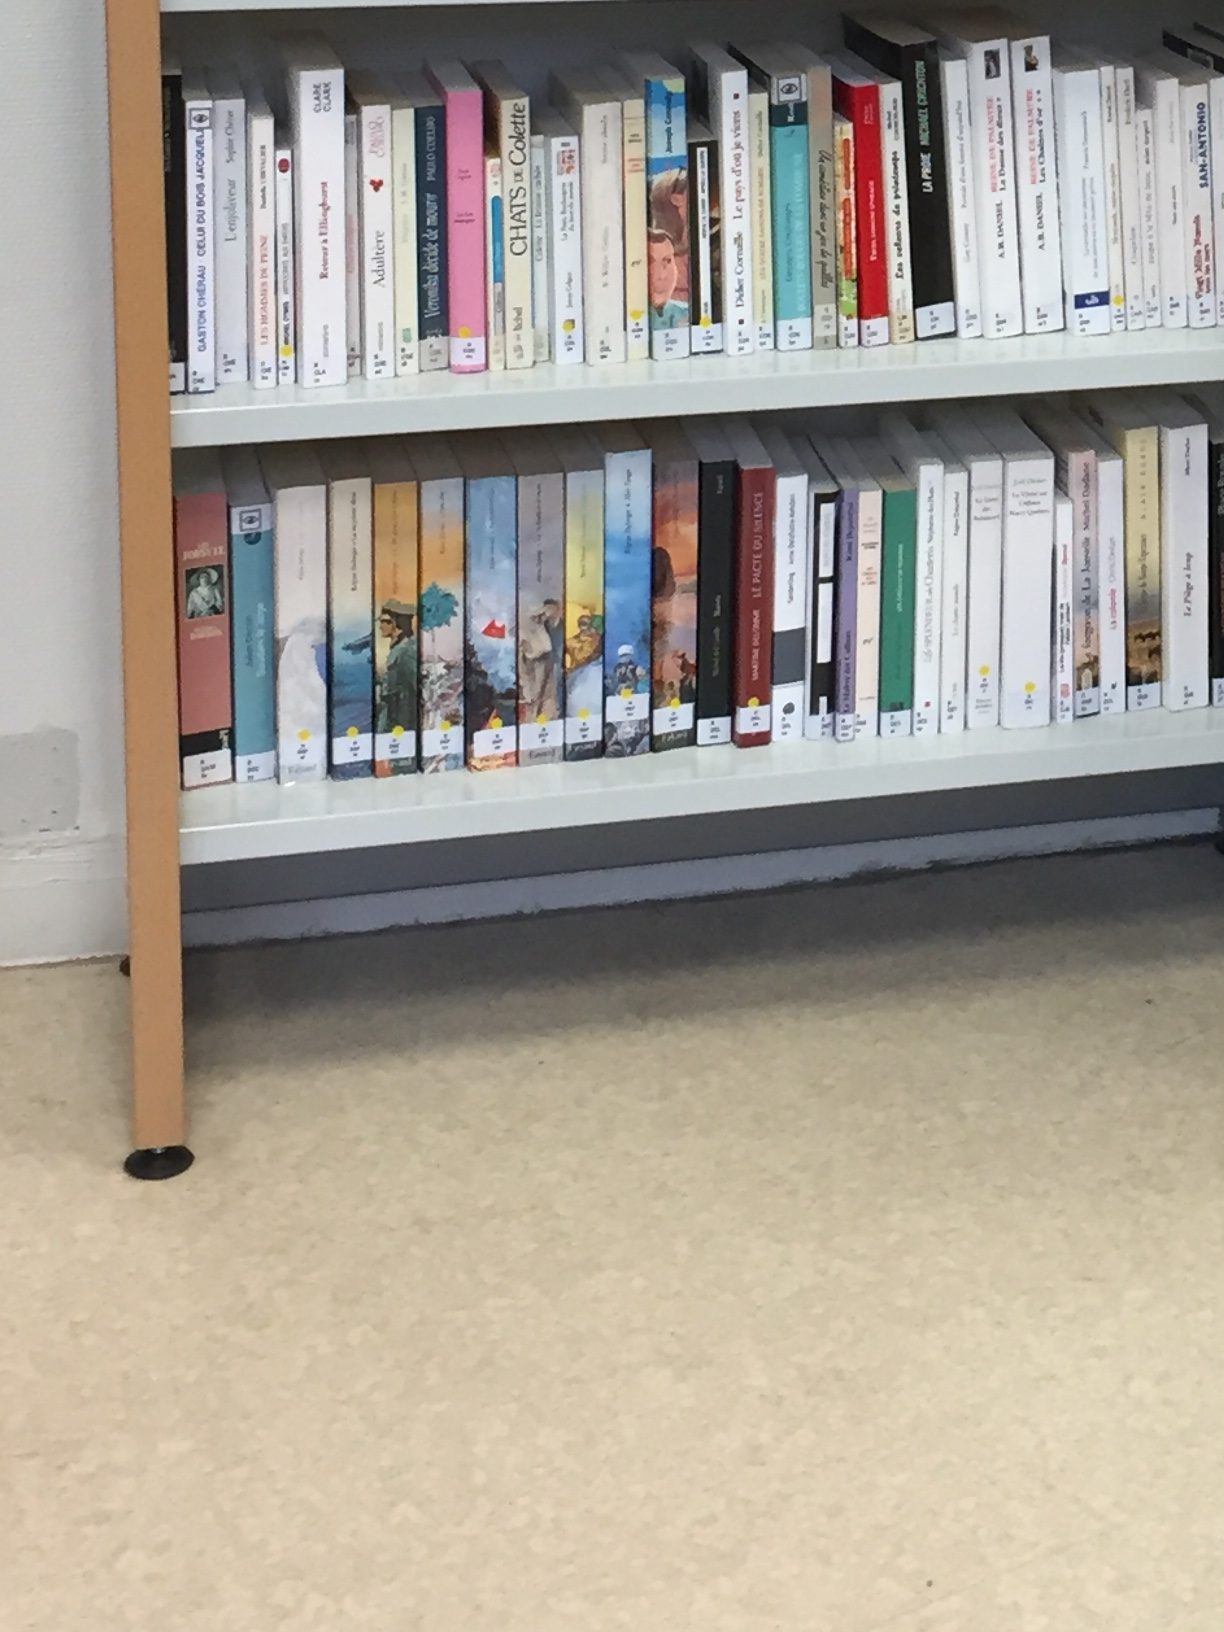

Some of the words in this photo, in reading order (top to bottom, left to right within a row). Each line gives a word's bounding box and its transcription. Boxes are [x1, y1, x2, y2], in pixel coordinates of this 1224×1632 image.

[322, 81, 332, 112] CLARK
[914, 60, 929, 106] CRICHTON
[509, 103, 526, 166] Colette
[731, 110, 742, 137] viens
[917, 108, 931, 146] MICHAEL
[732, 140, 744, 152] je
[1196, 102, 1209, 188] SAN-ANTONIO
[919, 152, 933, 179] PROIE
[196, 182, 206, 207] BOIS
[733, 180, 746, 202] pays
[922, 182, 934, 192] LA
[196, 210, 206, 224] DU
[509, 186, 528, 256] CHATS
[733, 206, 743, 219] Le
[196, 227, 206, 257] CELUI
[371, 230, 386, 287] Adultère
[194, 265, 206, 307] CHÉRAU
[424, 272, 441, 318] Veronika
[734, 278, 744, 307] Didier
[197, 310, 207, 352] GASTON
[752, 535, 762, 550] DU
[751, 553, 762, 582] PACTE
[752, 585, 762, 597] LE
